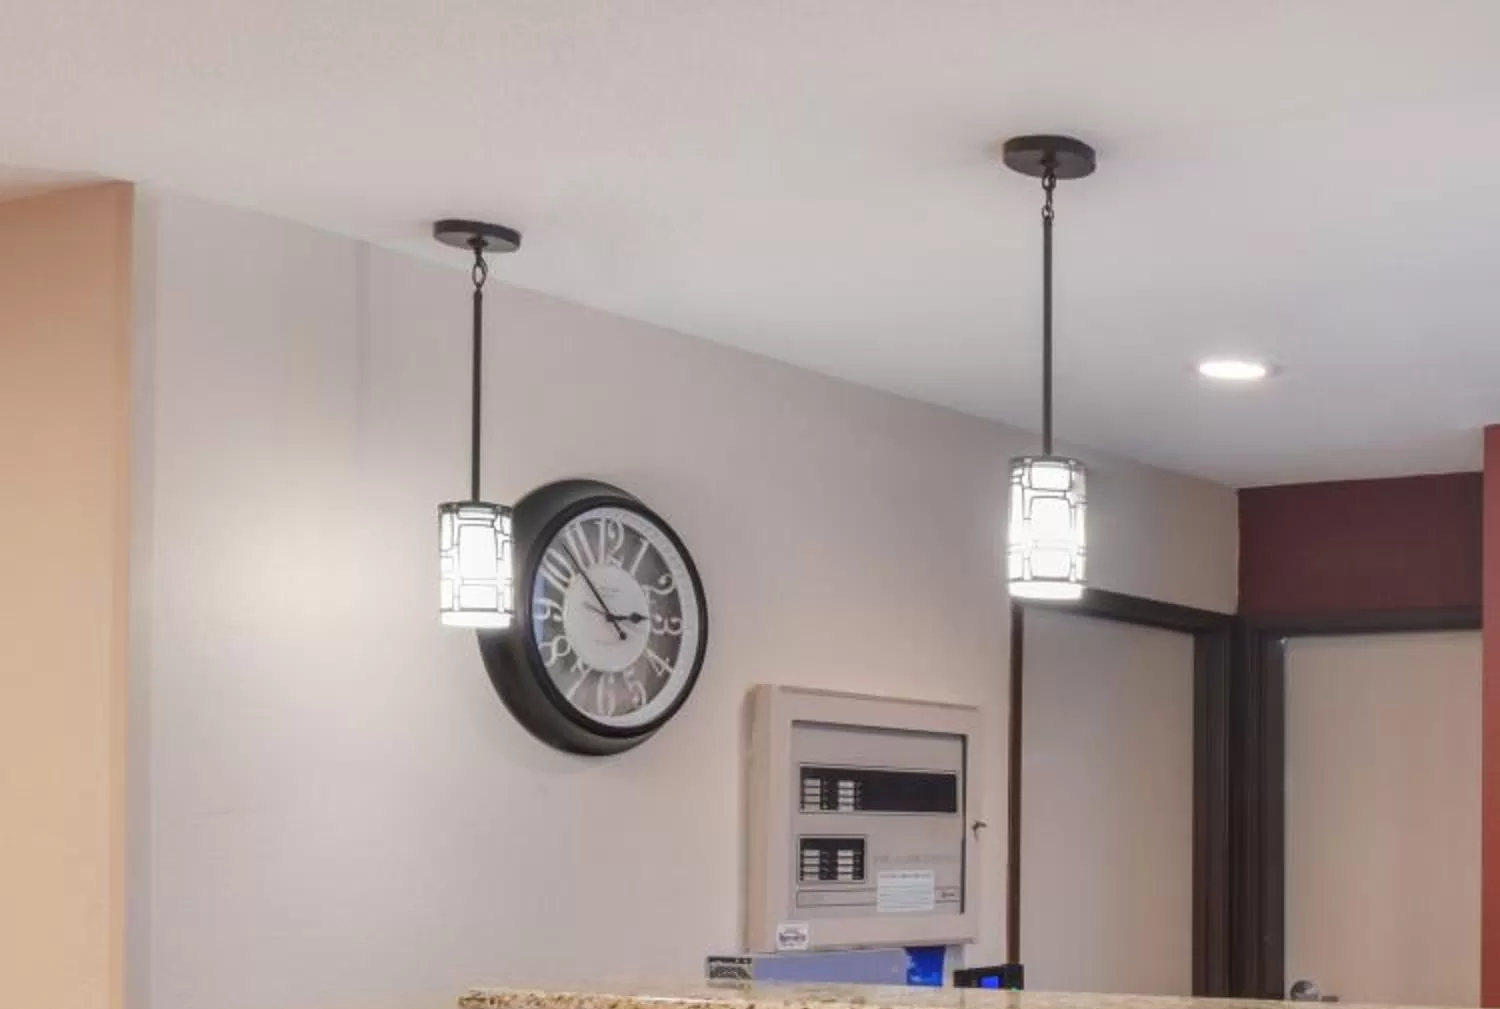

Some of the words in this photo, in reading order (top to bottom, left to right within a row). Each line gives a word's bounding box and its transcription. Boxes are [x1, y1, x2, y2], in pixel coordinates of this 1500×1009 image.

[595, 518, 625, 567] 12
[632, 538, 648, 575] 1
[540, 548, 574, 588] 10
[643, 574, 674, 600] 2
[534, 598, 563, 620] 9
[652, 613, 682, 635] 3
[540, 635, 572, 667] 8
[645, 648, 673, 677] 4
[566, 660, 590, 700] 7
[597, 673, 617, 717] 6
[624, 669, 646, 706] 5
